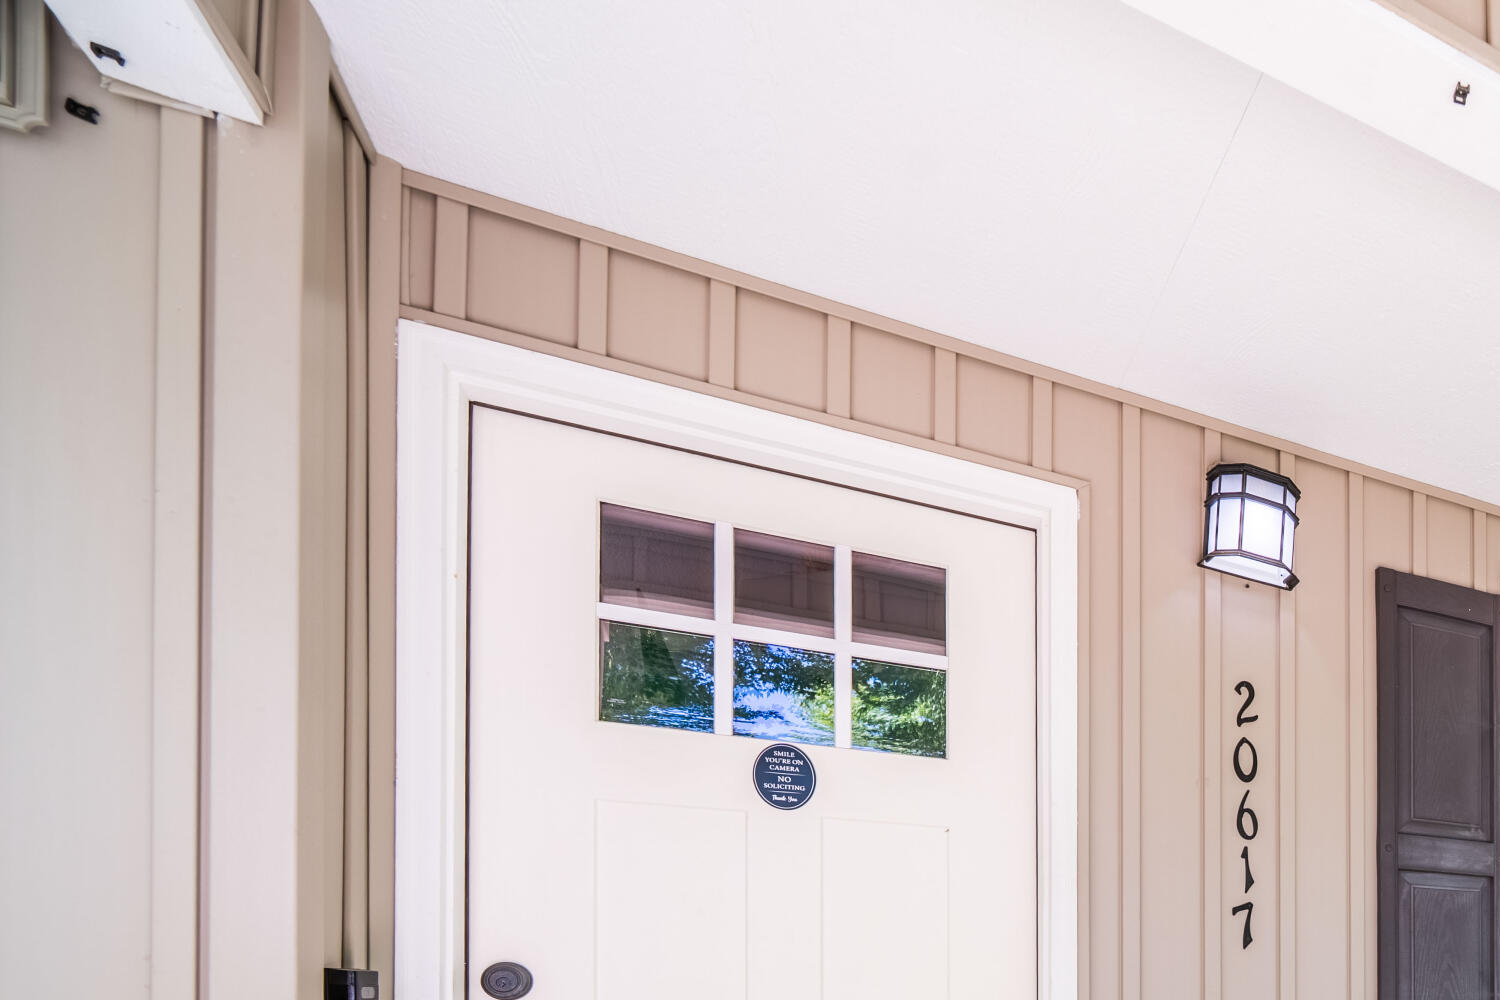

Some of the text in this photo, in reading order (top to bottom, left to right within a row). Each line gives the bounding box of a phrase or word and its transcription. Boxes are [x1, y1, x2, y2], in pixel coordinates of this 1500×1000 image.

[773, 750, 796, 758] SMILE
[765, 756, 791, 765] YOU'RE
[769, 764, 800, 772] CAMERA
[777, 775, 792, 783] NO
[763, 782, 806, 791] SOLICITING
[1232, 681, 1259, 950] 20617
